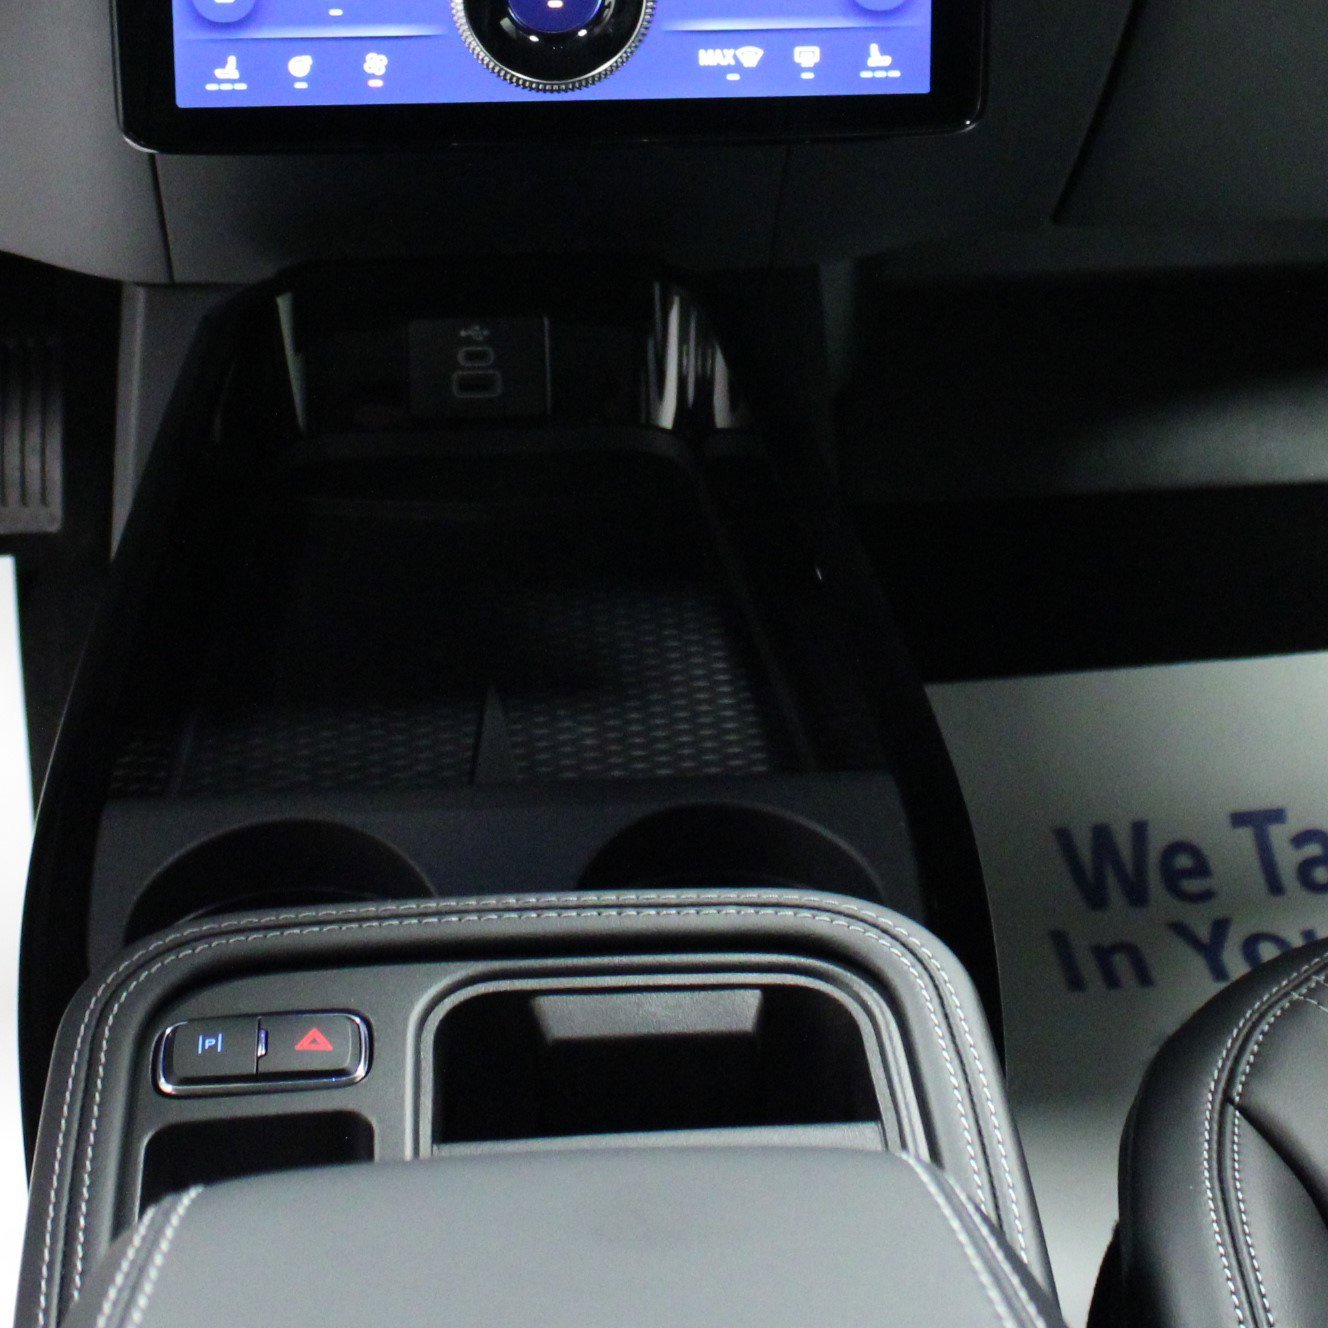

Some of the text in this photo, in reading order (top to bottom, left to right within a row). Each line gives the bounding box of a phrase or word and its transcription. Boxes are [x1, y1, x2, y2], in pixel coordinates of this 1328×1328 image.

[698, 48, 735, 66] MAX
[1051, 819, 1218, 913] We
[1048, 926, 1156, 994] In
